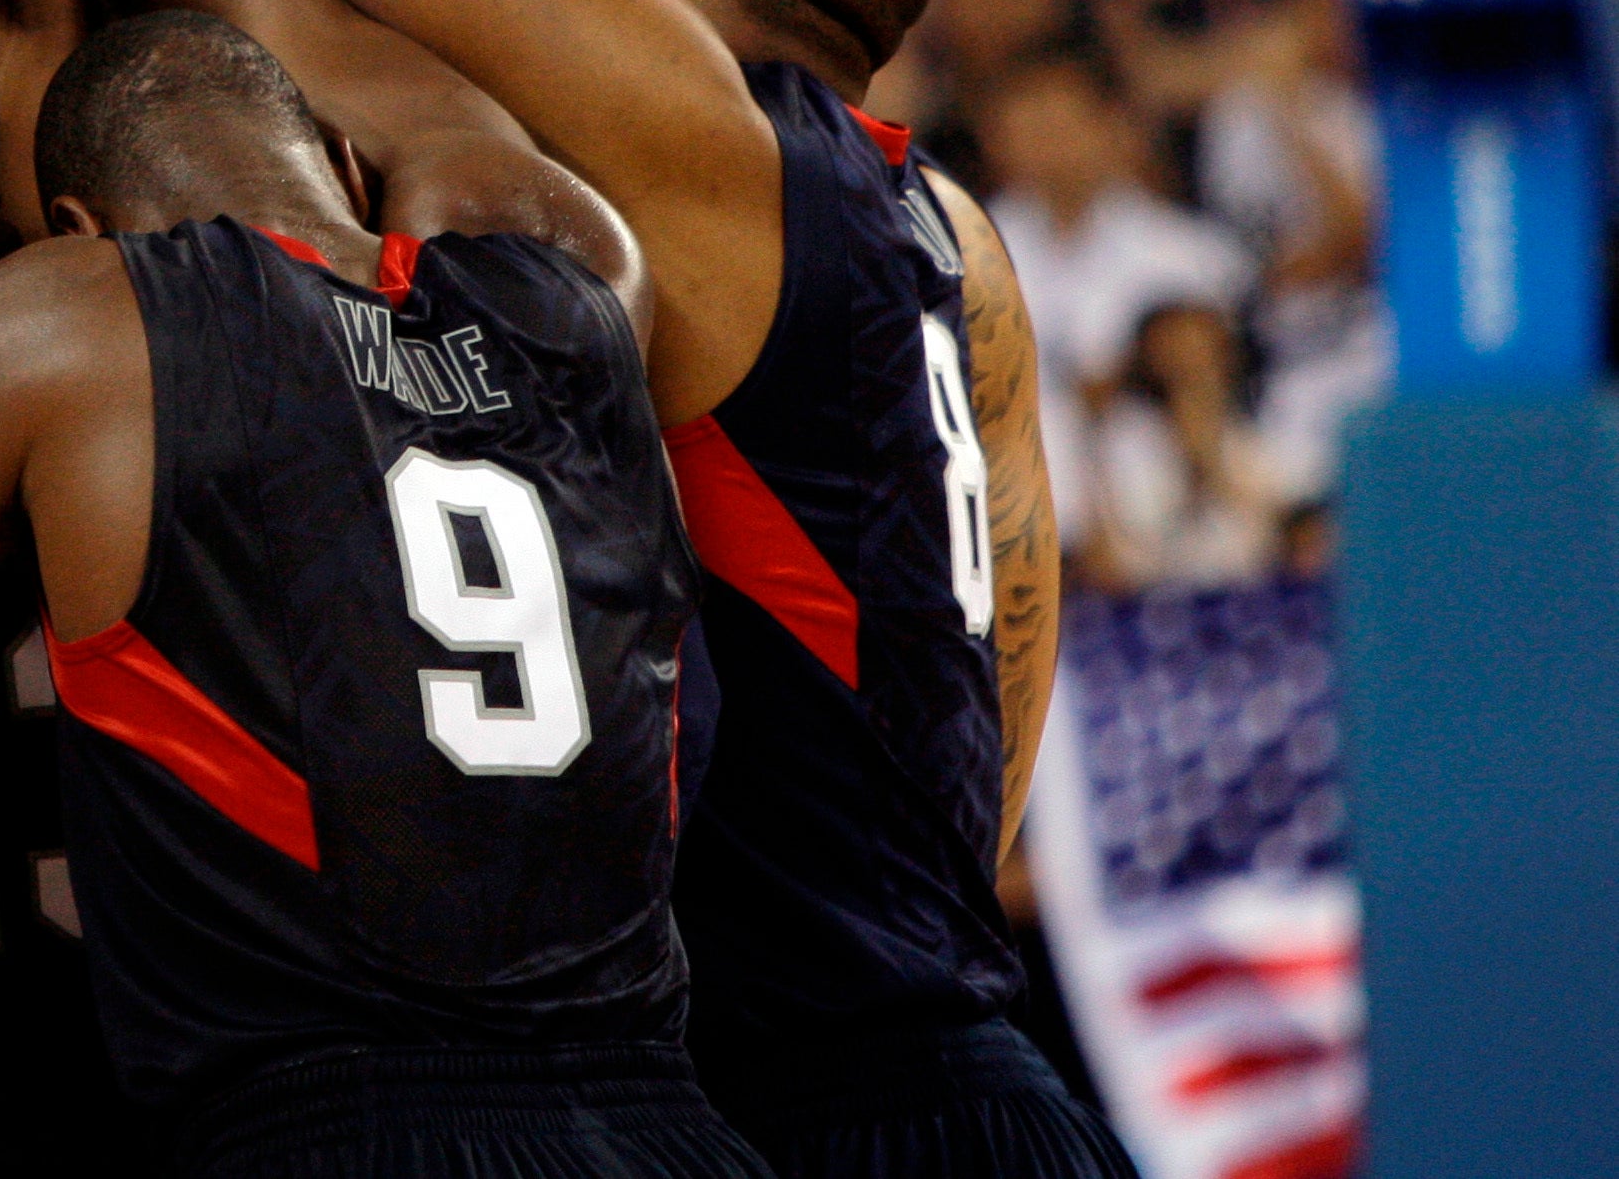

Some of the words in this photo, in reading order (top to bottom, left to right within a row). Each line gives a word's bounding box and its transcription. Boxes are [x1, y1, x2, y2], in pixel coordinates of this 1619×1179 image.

[333, 294, 513, 416] WADE
[920, 312, 995, 640] 8
[384, 446, 593, 778] 9
